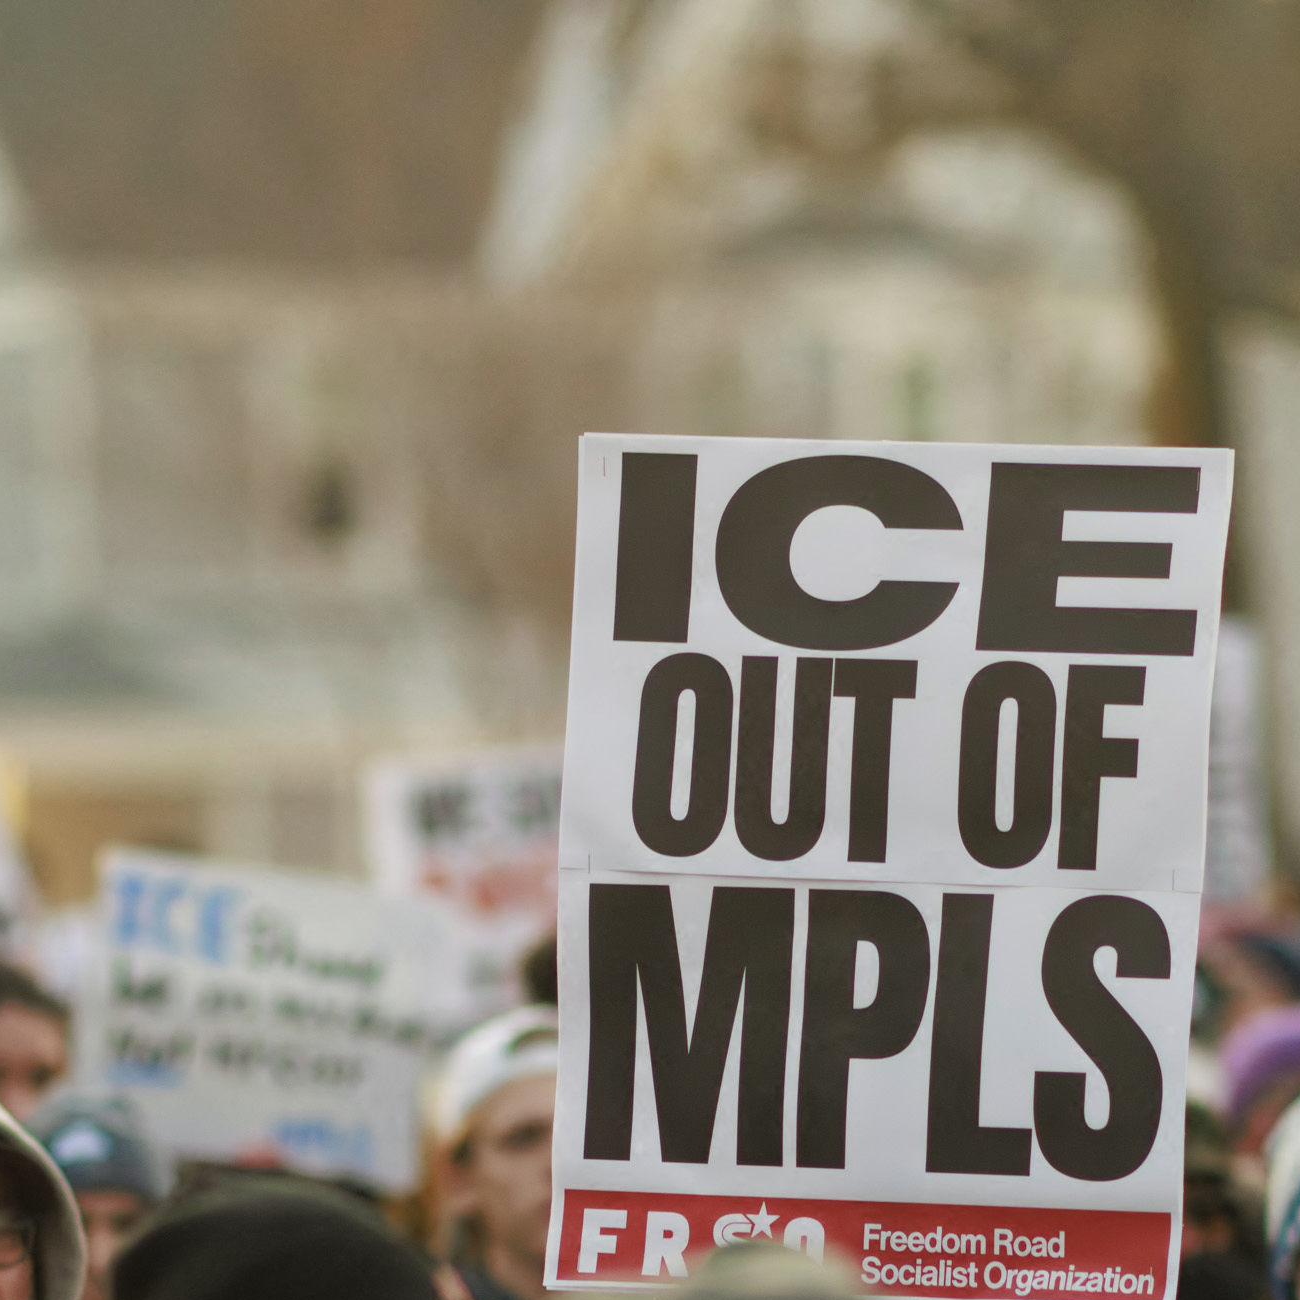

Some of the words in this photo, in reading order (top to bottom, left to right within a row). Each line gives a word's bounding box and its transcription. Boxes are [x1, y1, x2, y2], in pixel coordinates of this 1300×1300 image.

[612, 451, 1202, 657] ICE
[631, 652, 919, 864] OUT
[957, 660, 1147, 871] OF
[582, 883, 1172, 1182] MPLS
[860, 1255, 979, 1288] Socialist
[983, 1260, 1156, 1297] Organization
[863, 1223, 987, 1256] Freedom
[993, 1228, 1066, 1259] Road
